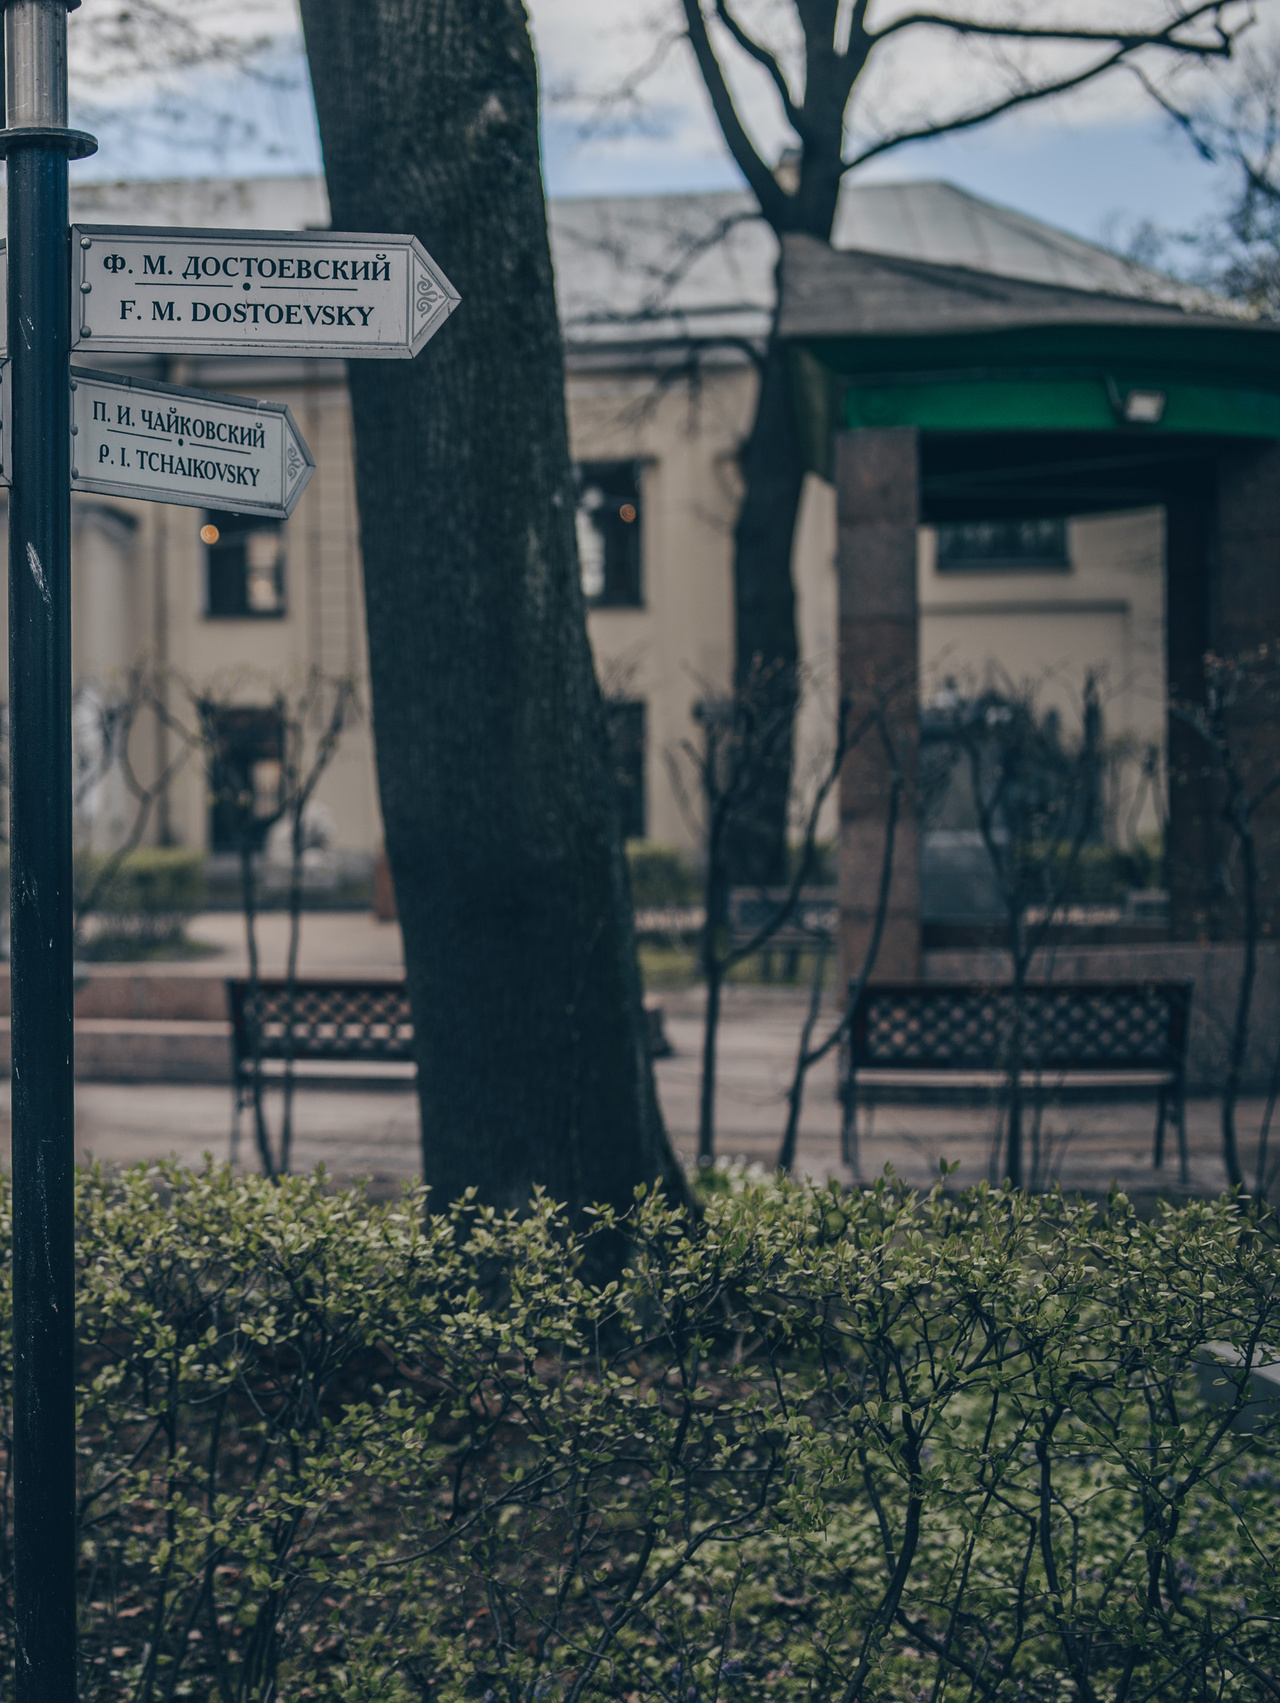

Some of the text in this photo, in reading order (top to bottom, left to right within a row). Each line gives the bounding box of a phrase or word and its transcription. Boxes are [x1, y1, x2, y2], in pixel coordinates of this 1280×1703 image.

[103, 253, 391, 282] Ф. М. ДОСТОЕВСКИЙ
[120, 300, 374, 326] F. M. DOSTOEVSKY
[93, 401, 265, 448] П. И. ЧАЙКОВСКИЙ
[98, 444, 260, 487] P. I. TCHAIKOVSKY
